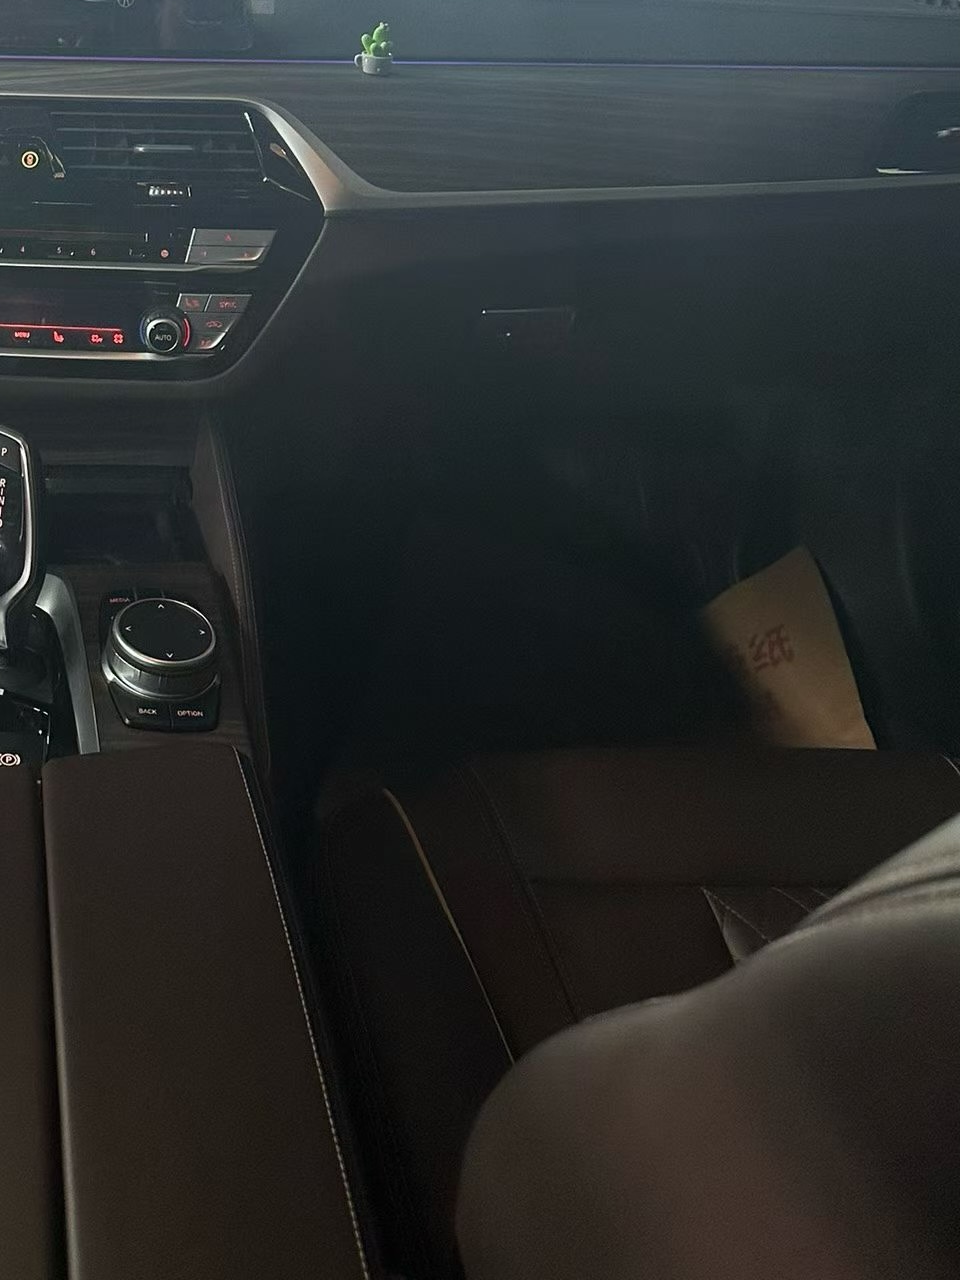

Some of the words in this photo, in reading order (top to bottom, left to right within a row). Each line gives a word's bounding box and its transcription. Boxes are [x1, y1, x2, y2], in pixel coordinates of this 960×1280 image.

[1, 447, 8, 456] P
[0, 478, 6, 487] R
[177, 709, 204, 717] OPTION
